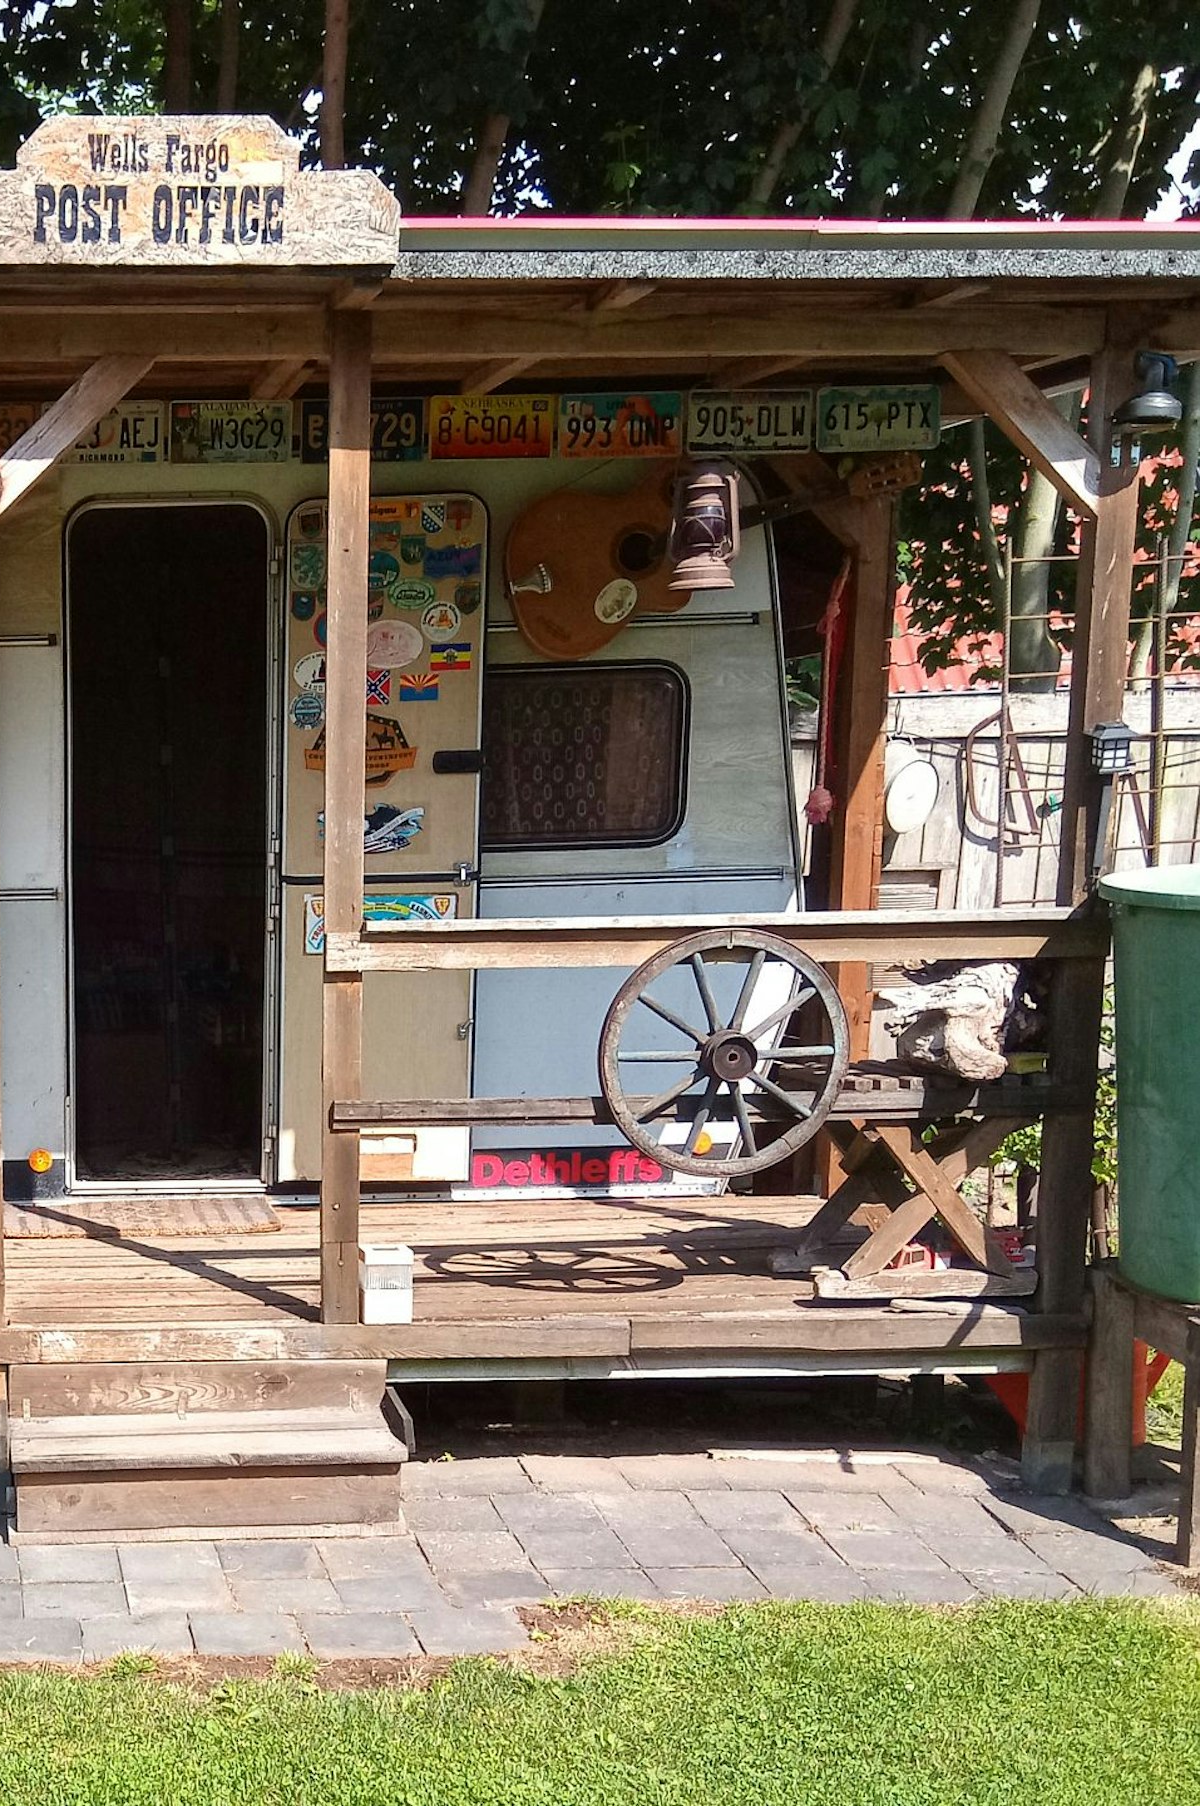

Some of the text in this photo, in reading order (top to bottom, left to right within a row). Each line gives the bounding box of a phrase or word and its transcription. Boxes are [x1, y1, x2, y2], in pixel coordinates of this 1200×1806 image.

[87, 133, 231, 184] Wells Fargo
[33, 184, 286, 245] POST OFFICE
[567, 416, 613, 449] 993
[696, 406, 744, 438] 905
[825, 401, 932, 431] 615 PTX
[119, 417, 159, 449] AEJ
[472, 1150, 664, 1188] Dethleffs
